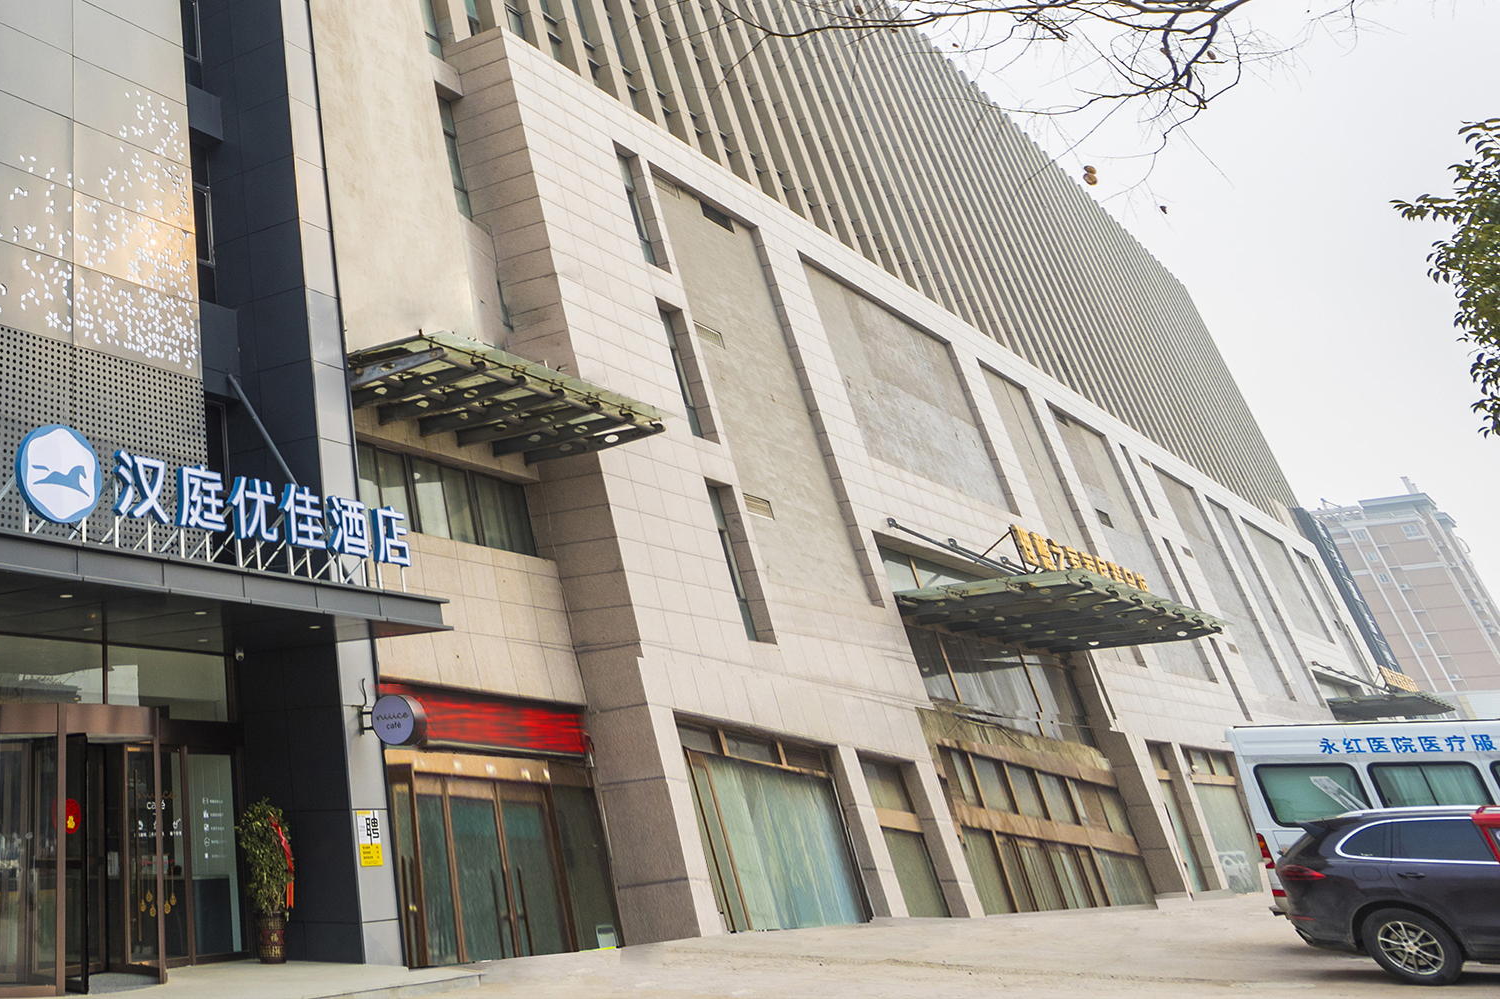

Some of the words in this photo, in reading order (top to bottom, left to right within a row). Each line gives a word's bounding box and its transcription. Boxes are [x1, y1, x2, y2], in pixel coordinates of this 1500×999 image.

[113, 449, 411, 567] 汉庭优佳酒店
[1319, 734, 1497, 755] 永红医院医疗服
[146, 799, 166, 810] caé
